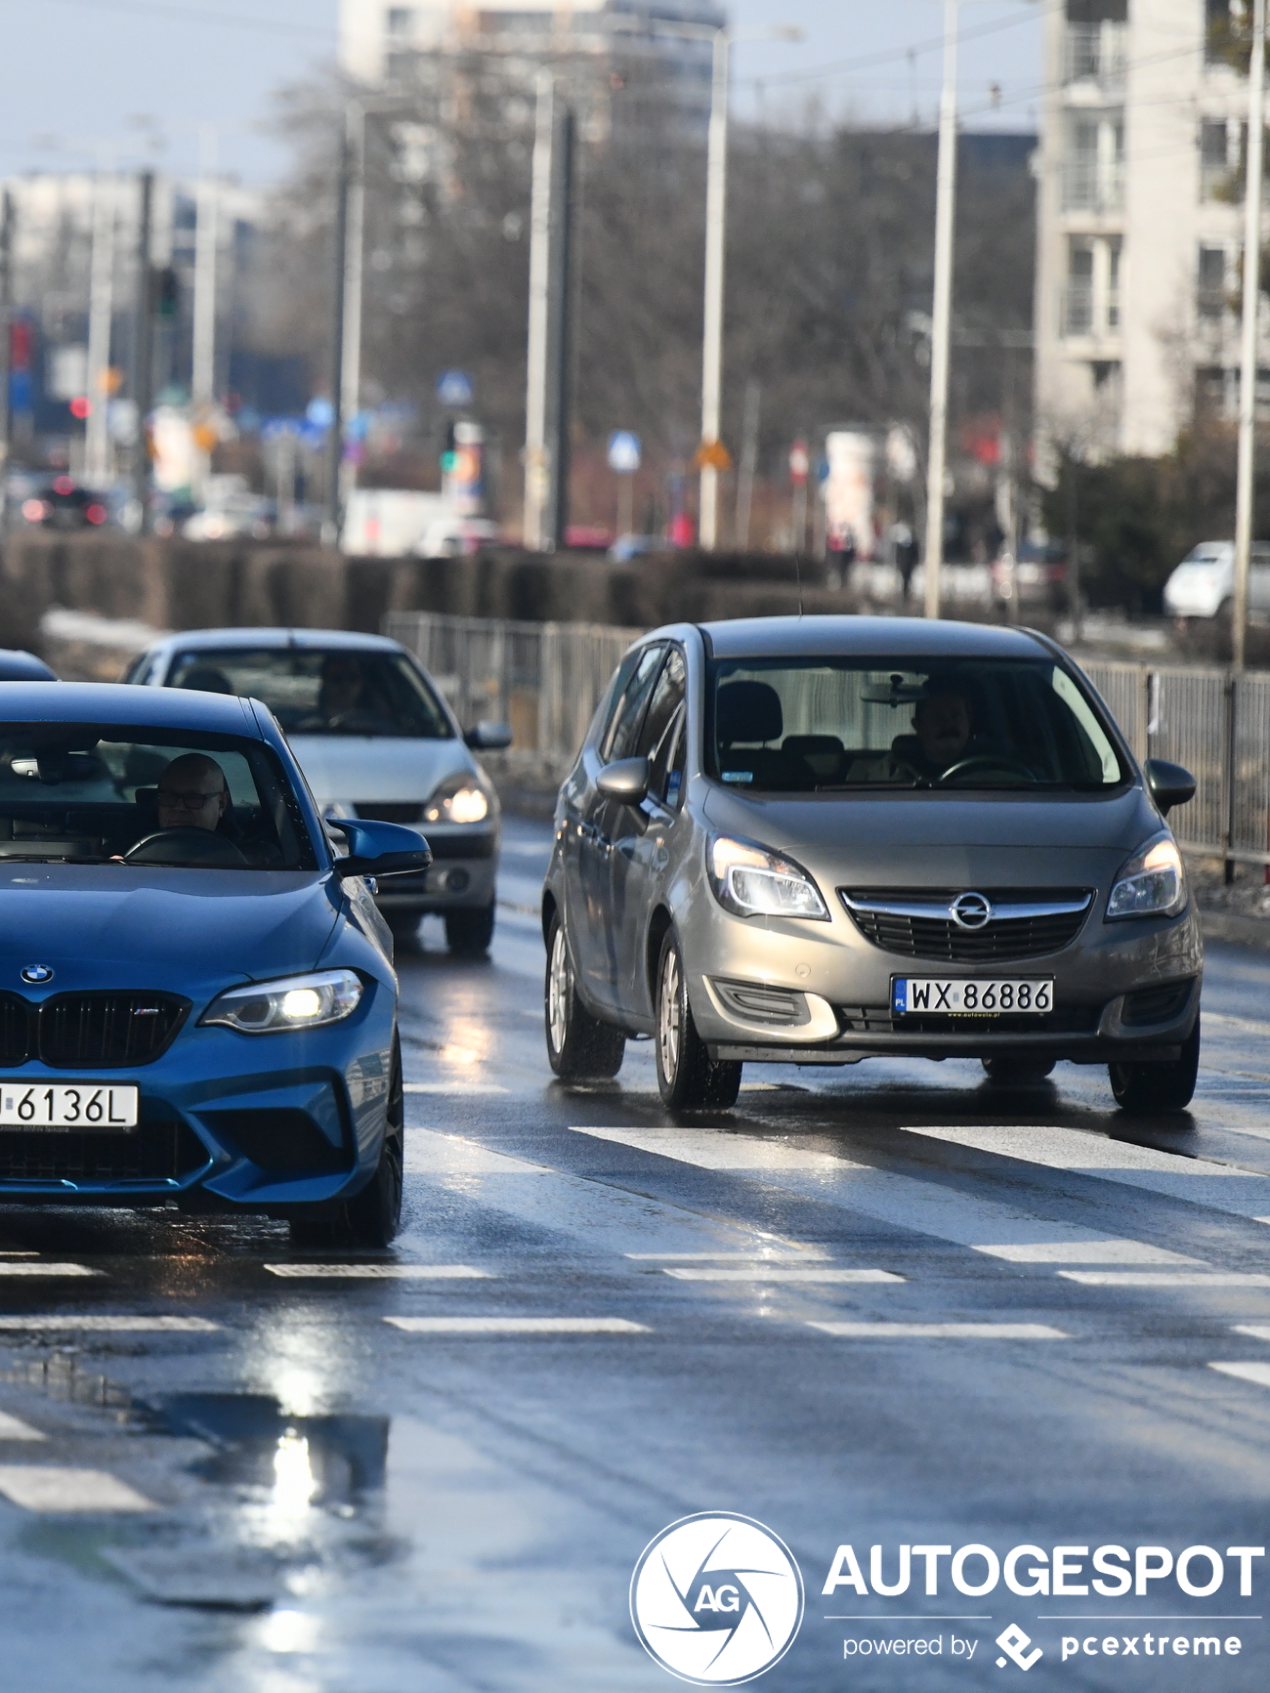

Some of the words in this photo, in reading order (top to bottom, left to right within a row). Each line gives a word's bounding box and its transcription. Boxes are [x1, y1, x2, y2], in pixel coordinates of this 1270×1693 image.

[895, 998, 906, 1008] PL
[912, 983, 952, 1010] WX
[962, 983, 1050, 1010] 86886
[17, 1088, 127, 1123] 6136L
